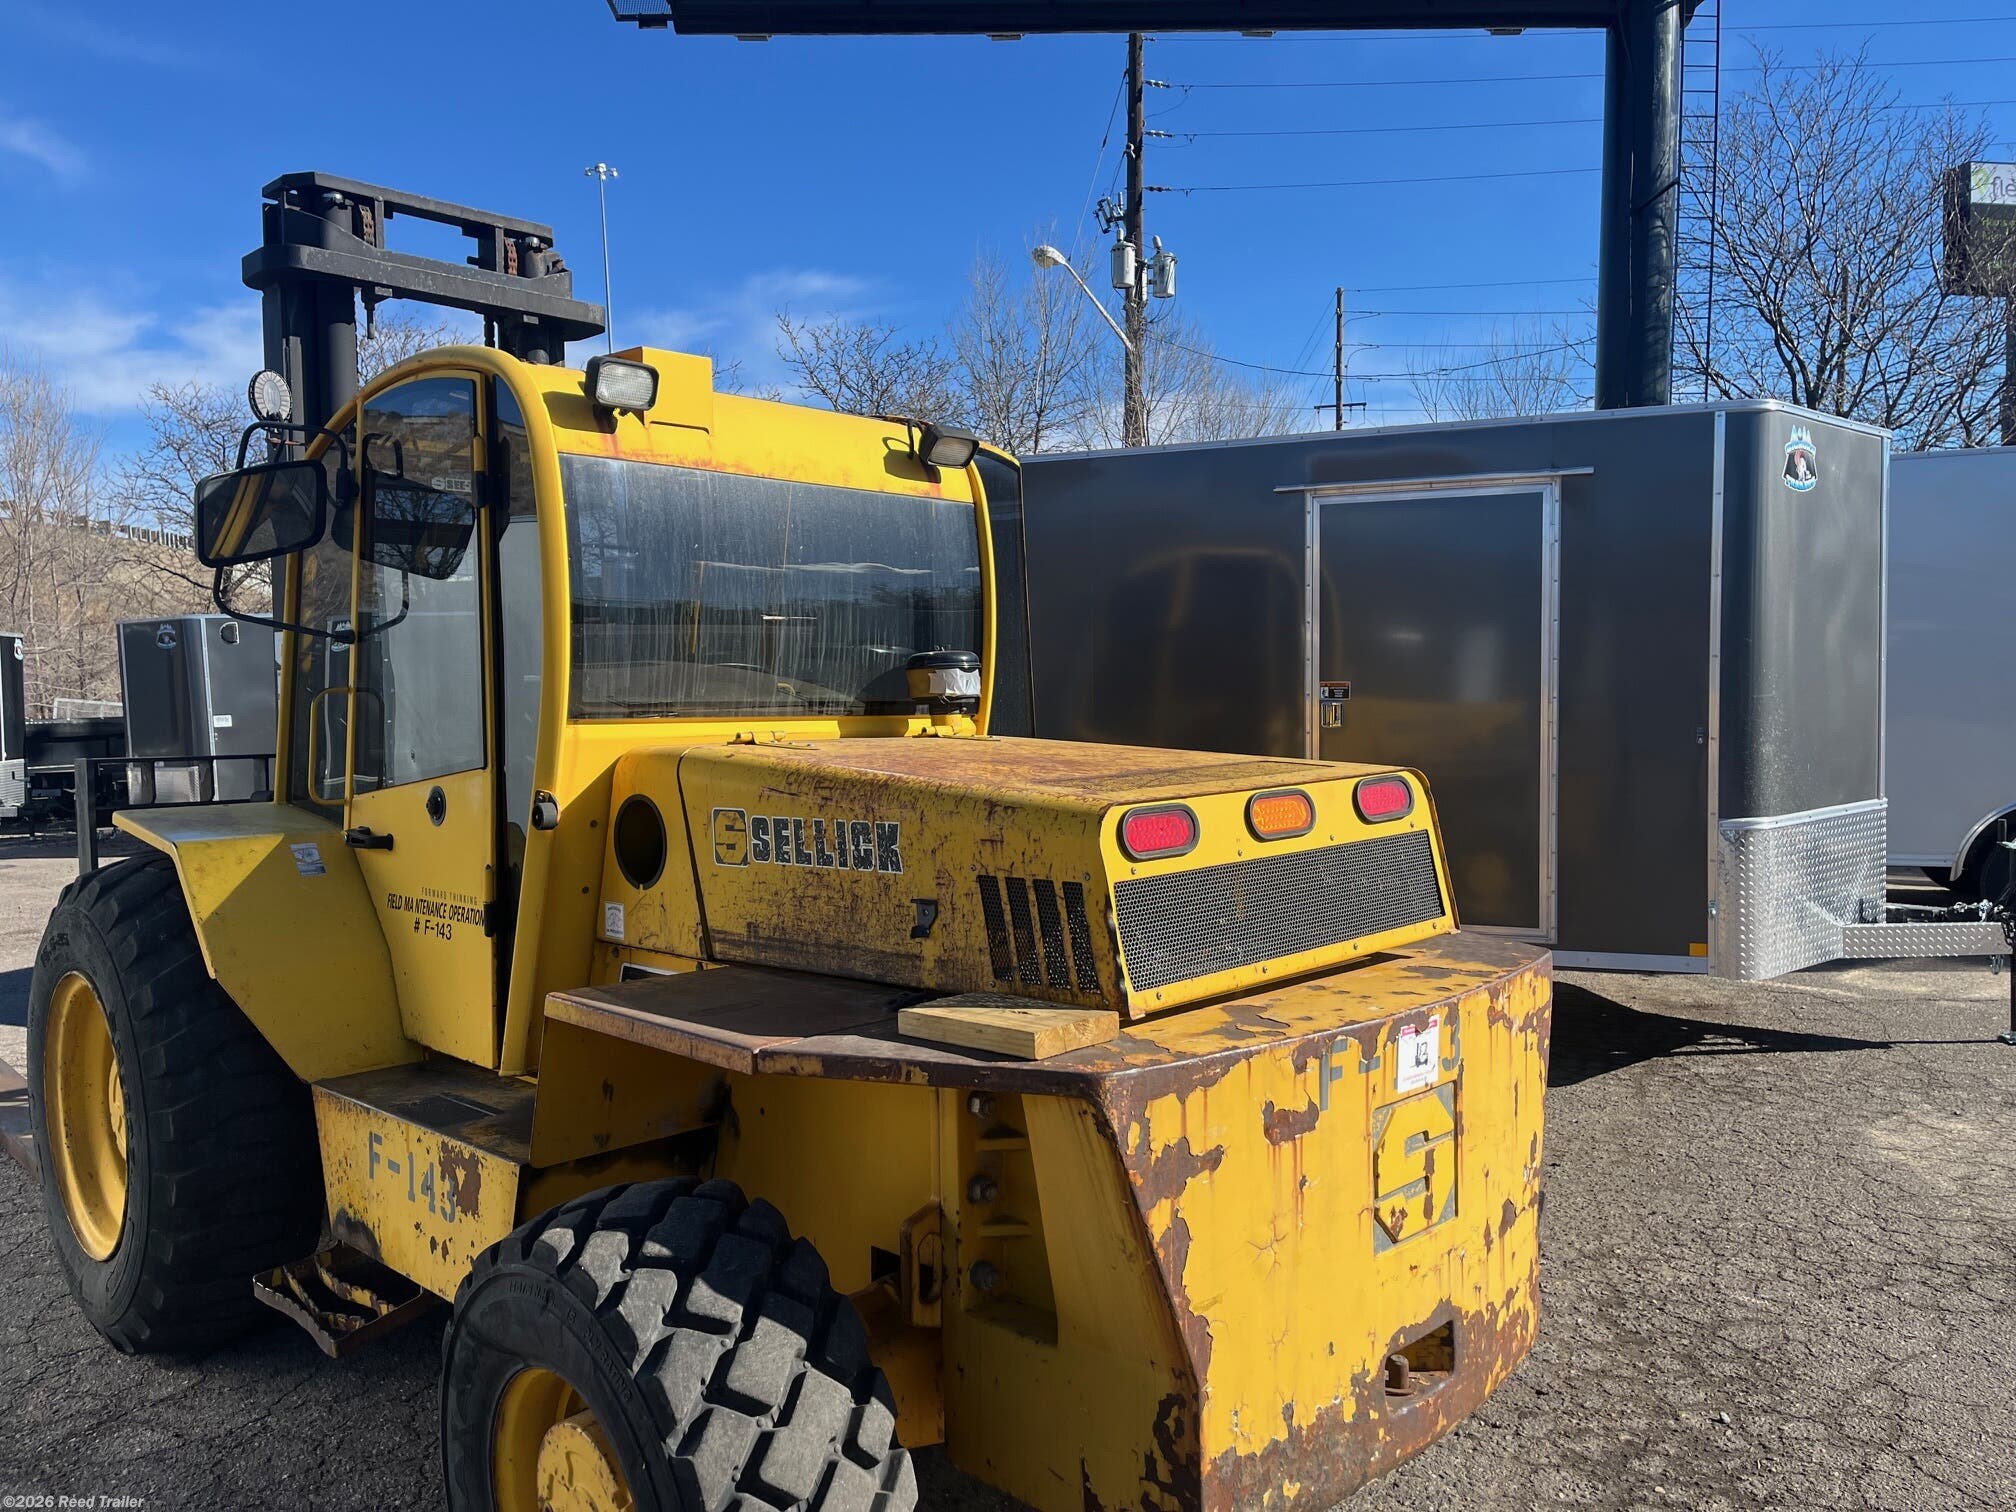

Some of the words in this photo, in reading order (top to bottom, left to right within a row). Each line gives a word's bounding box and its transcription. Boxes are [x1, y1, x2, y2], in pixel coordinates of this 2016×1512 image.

[751, 815, 903, 874] SELLICK
[387, 893, 403, 910] FIELD
[421, 886, 447, 900] FORWARD
[449, 891, 478, 906] THINKING
[414, 917, 420, 933] #
[424, 919, 452, 940] F-143
[1319, 1014, 1460, 1112] F-3
[369, 1131, 455, 1223] F-143
